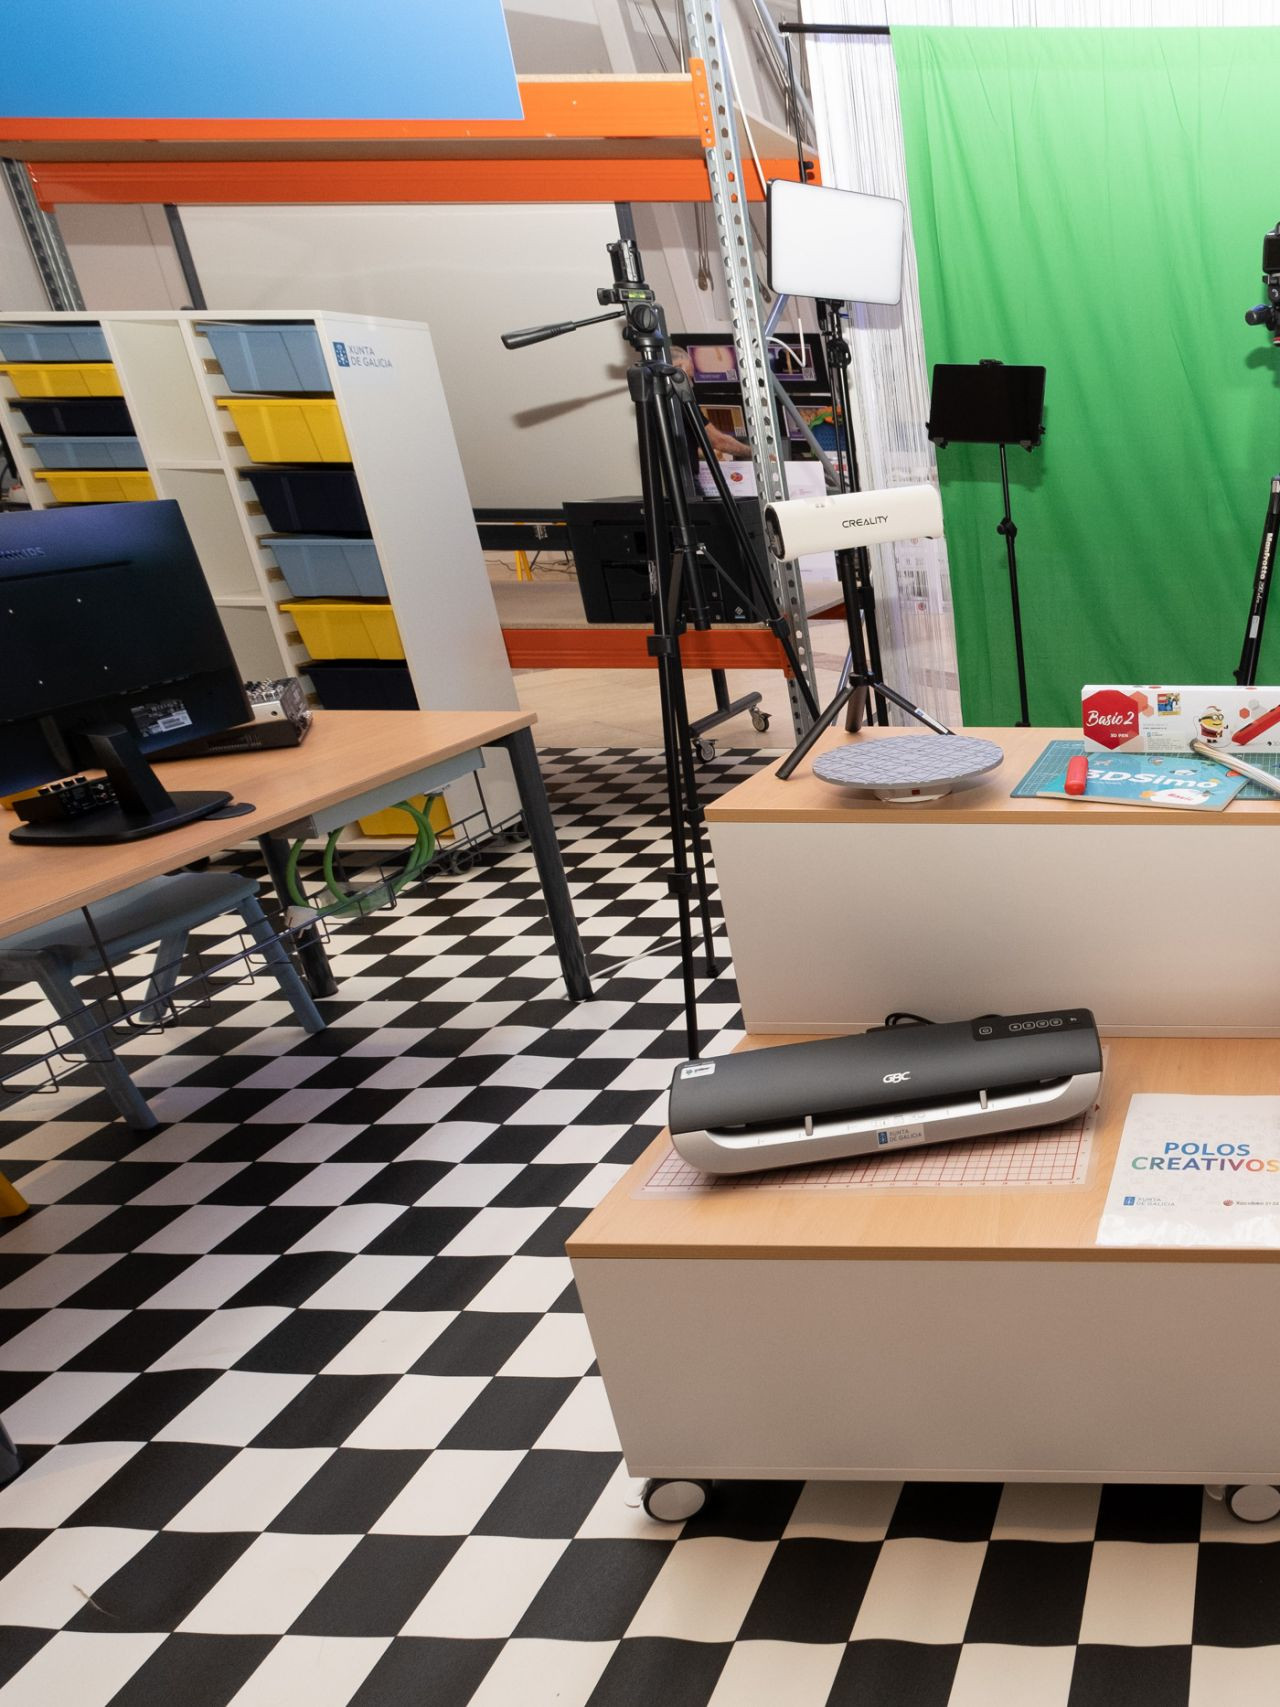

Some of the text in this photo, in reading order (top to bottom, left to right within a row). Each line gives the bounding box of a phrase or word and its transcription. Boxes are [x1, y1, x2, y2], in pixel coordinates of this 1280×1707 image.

[348, 345, 376, 356] XUNTA
[350, 356, 393, 368] DE GALICIA
[842, 515, 888, 529] CREALITY
[1260, 532, 1273, 580] Manfrotto
[1086, 710, 1135, 727] Basic 2
[1087, 769, 1217, 788] 3DSimo
[883, 1071, 911, 1083] GBC
[1164, 1142, 1250, 1156] POLOS
[1132, 1156, 1280, 1172] CREATIVOS
